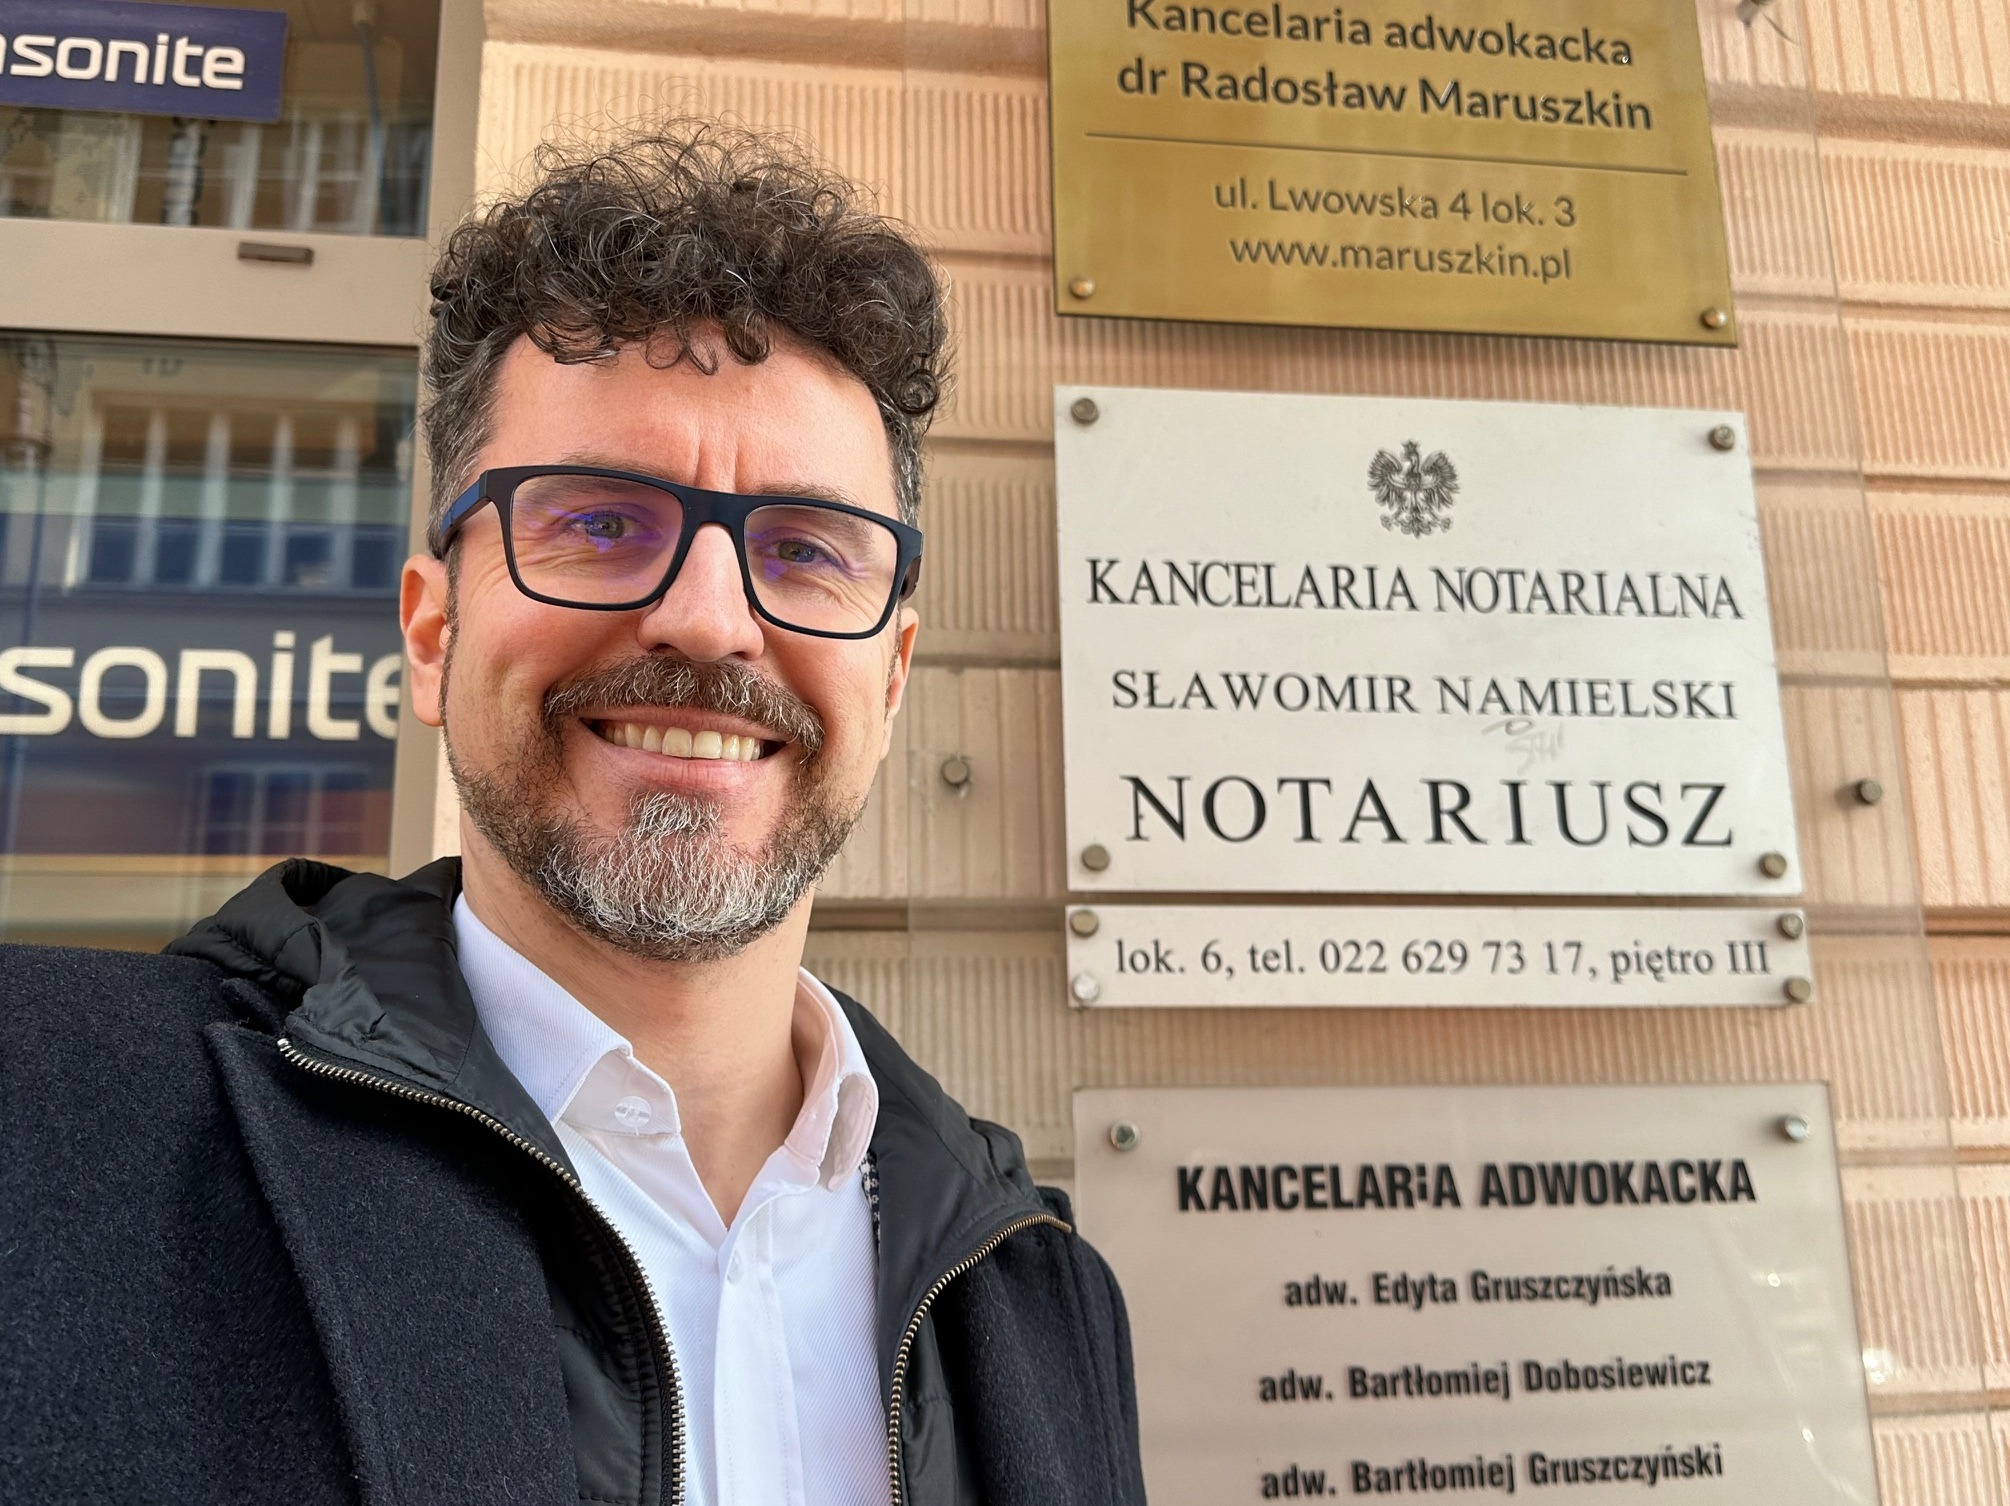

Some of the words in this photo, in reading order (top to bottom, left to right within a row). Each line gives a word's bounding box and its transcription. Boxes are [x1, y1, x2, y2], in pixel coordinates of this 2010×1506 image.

[1126, 0, 1372, 46] Kancelaria
[1384, 15, 1633, 66] adwokacka
[0, 34, 246, 91] sonite
[1117, 57, 1167, 95] dr
[1181, 61, 1407, 112] Radosław
[1419, 77, 1653, 131] Maruszkin
[1215, 178, 1258, 211] ul.
[1269, 180, 1439, 221] Lwowska
[1448, 187, 1472, 221] 4
[1482, 190, 1545, 226] lok.
[1554, 197, 1577, 228] 3
[1230, 237, 1572, 284] www.maruszkin.pl
[1087, 558, 1421, 612] KANCELARIA
[1433, 566, 1746, 620] NOTARIALNA
[1112, 670, 1420, 713] SŁAWOMIR
[1436, 676, 1738, 720] NAMIELSKI
[1120, 774, 1735, 849] NOTARIUSZ
[1116, 939, 1185, 975] lok.
[1200, 940, 1234, 979] 6,
[1247, 940, 1305, 975] tel.
[1318, 939, 1388, 974] 022
[1401, 940, 1468, 974] 629
[1482, 940, 1525, 974] 73
[1545, 940, 1597, 980] 17,
[1610, 943, 1716, 983] piętro
[1727, 940, 1770, 974] III
[1478, 1158, 1757, 1208] ADWOKACKA
[1284, 1275, 1358, 1308] adw.
[1372, 1271, 1458, 1310] Edyta
[1470, 1264, 1673, 1306] Gruszczyńska
[1258, 1370, 1334, 1404] adw.
[1347, 1360, 1512, 1402] Bartłomiej
[1523, 1355, 1712, 1396] Dobosiewicz
[1260, 1463, 1337, 1500] adw.
[1350, 1454, 1516, 1497] Bartłomiej
[1527, 1443, 1724, 1489] Gruszczyński
